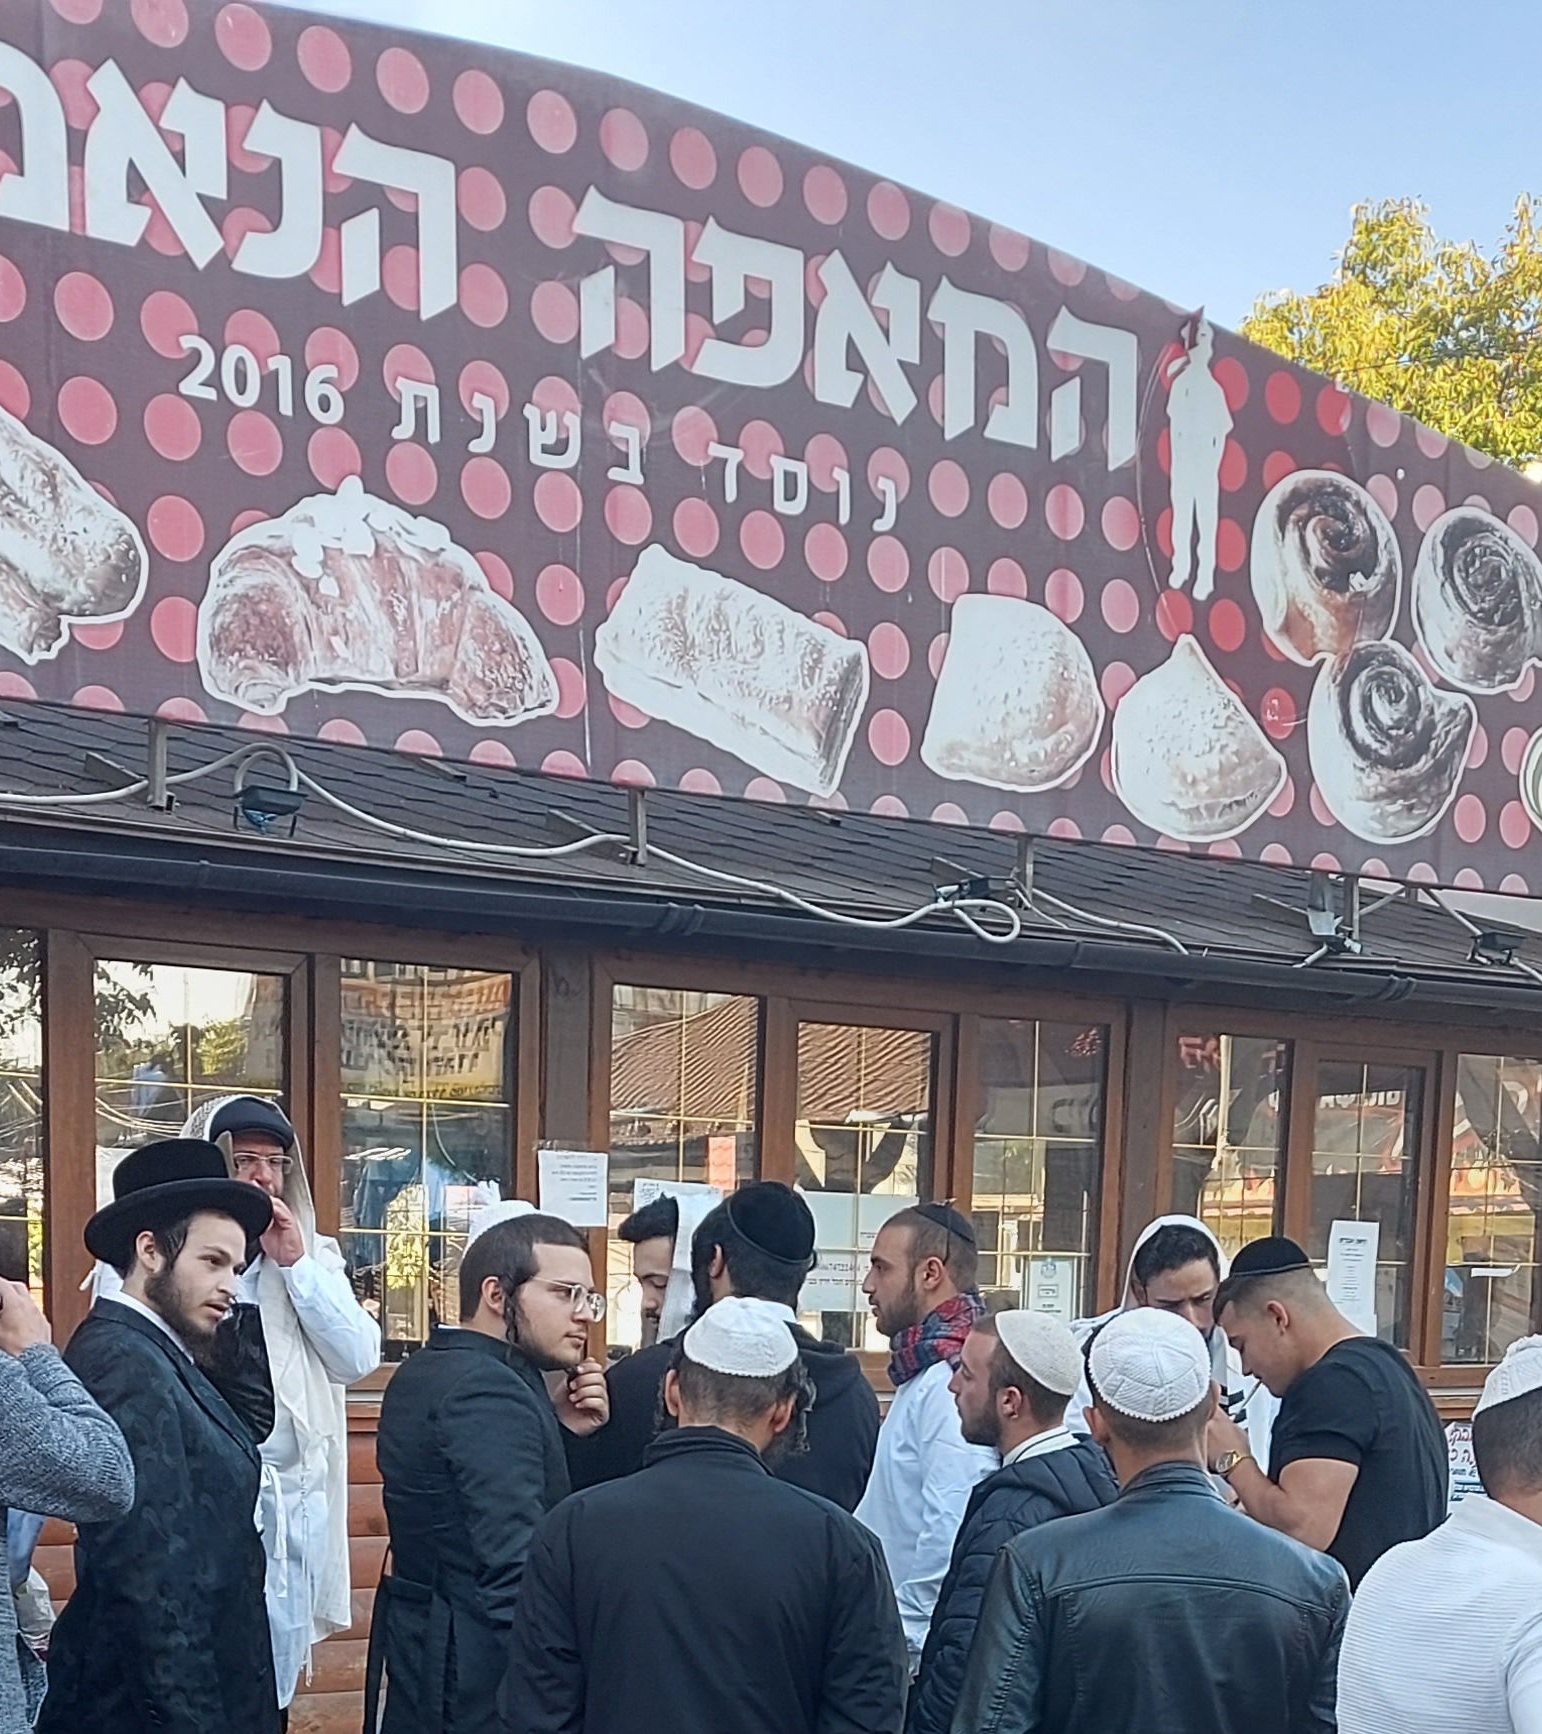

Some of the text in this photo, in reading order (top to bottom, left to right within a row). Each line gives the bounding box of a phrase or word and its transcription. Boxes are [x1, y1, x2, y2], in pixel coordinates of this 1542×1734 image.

[177, 334, 898, 533] נוסד בשנת 2016
[572, 184, 1139, 471] המאפה
